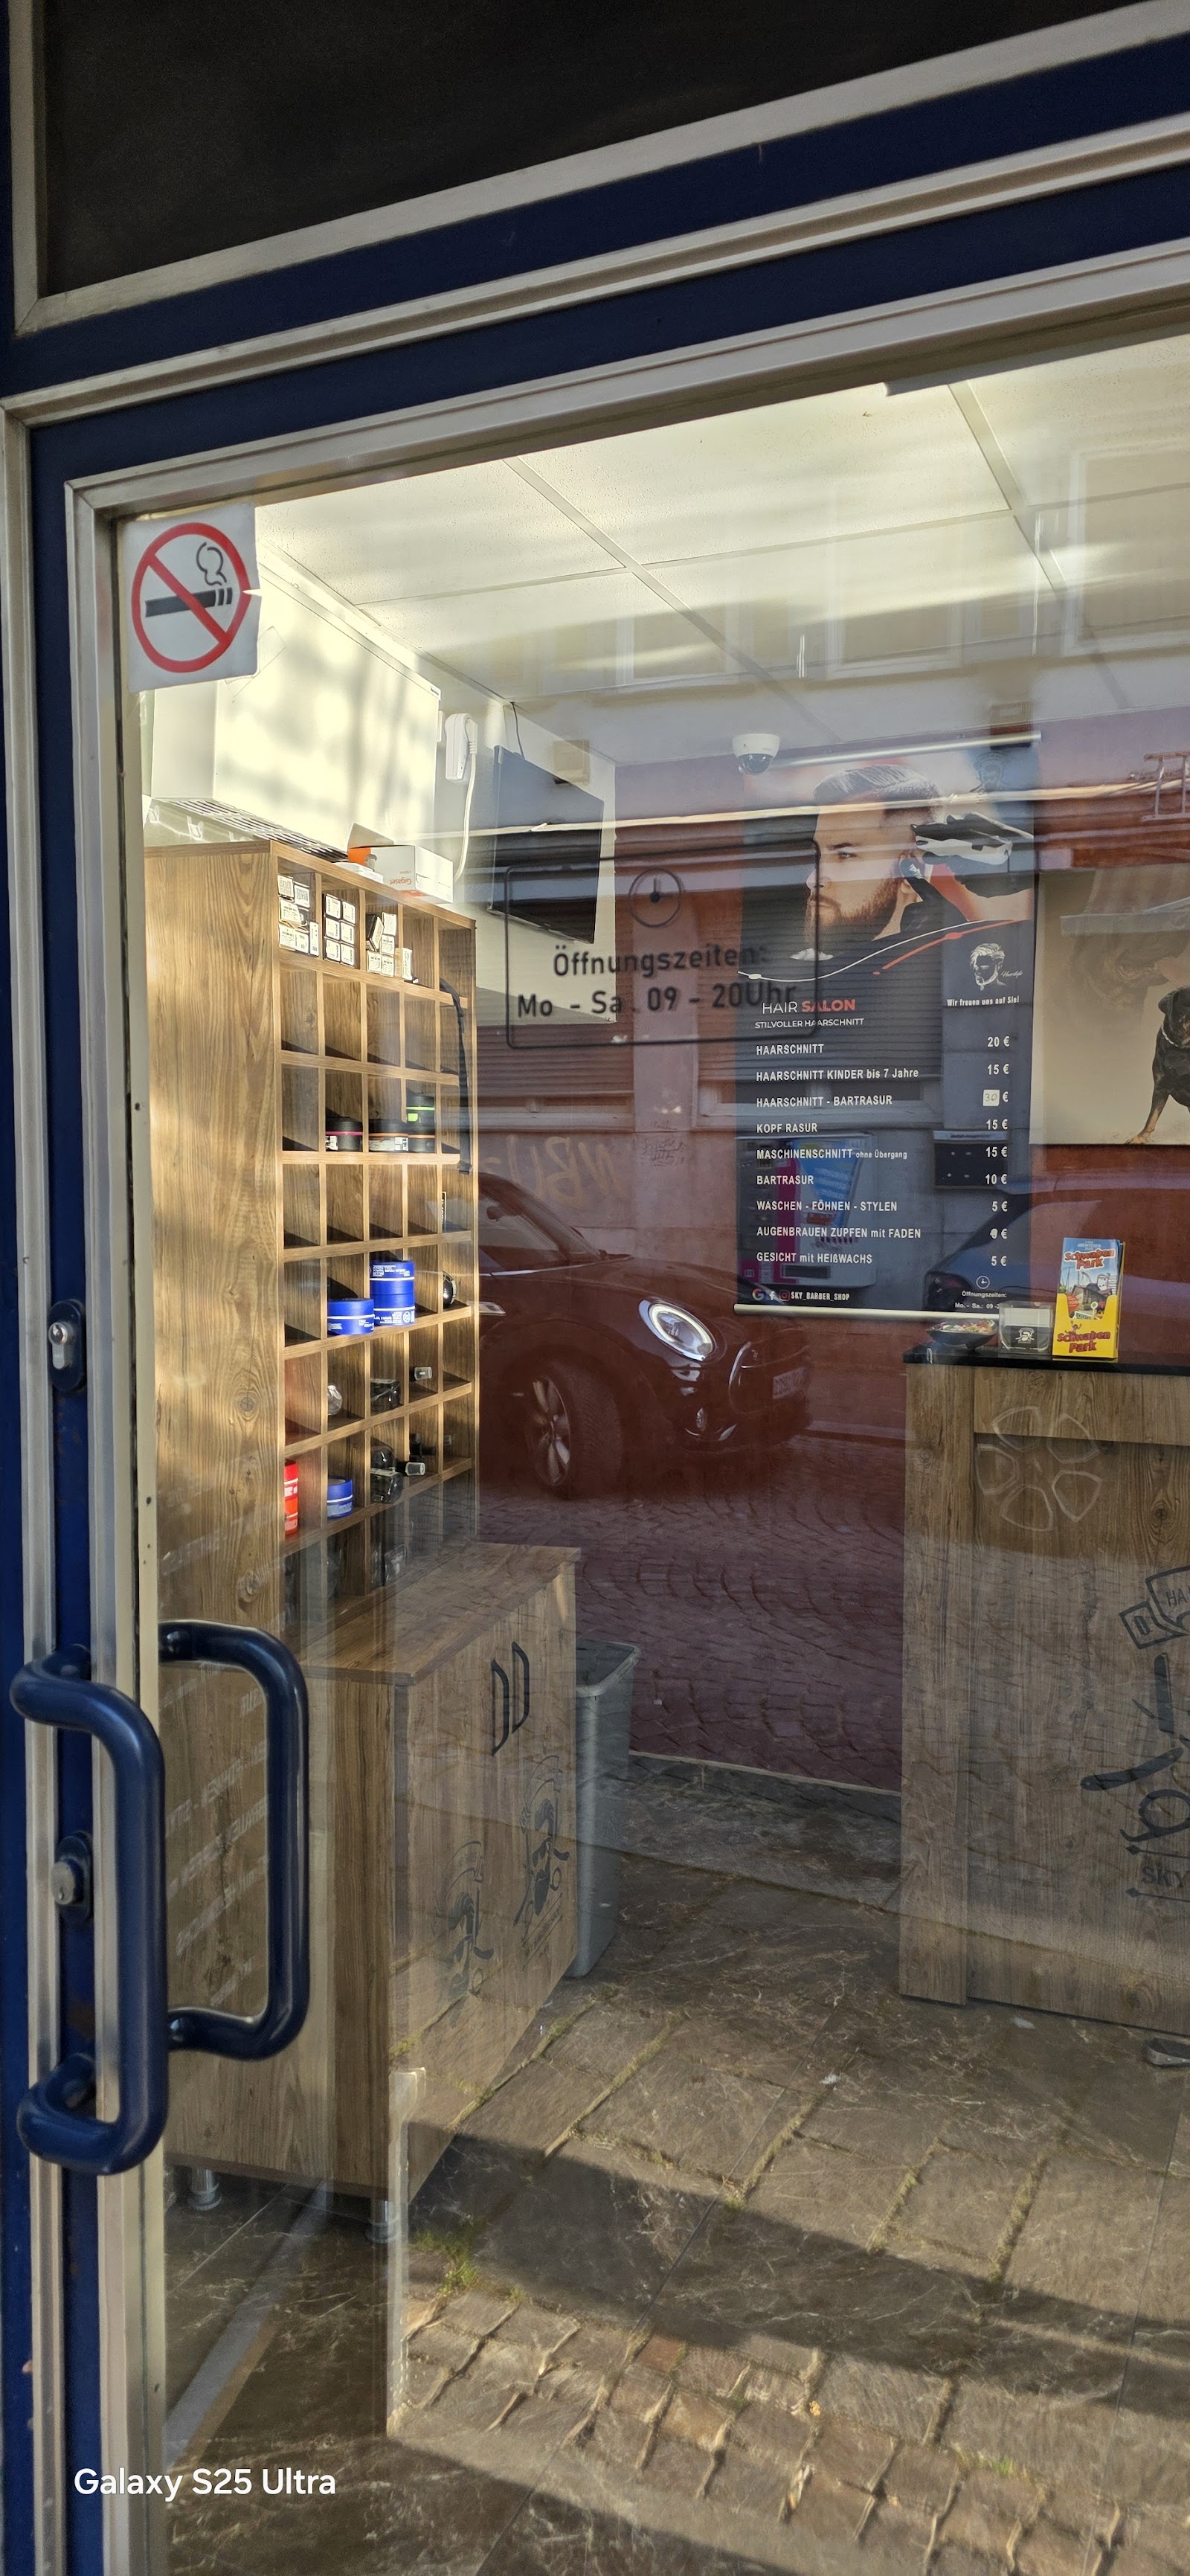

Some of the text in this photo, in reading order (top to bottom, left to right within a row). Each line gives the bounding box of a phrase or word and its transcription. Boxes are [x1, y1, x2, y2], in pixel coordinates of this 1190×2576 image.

[389, 877, 412, 885] Gigaset
[648, 987, 678, 1012] 09
[959, 998, 980, 1006] freuen
[995, 997, 1006, 1005] auf
[1007, 995, 1020, 1003] Sie!
[762, 999, 856, 1014] HAIR SALON
[755, 1018, 864, 1029] STILVOLLER HAARSCHNITT
[987, 1035, 1010, 1047] 20 €
[756, 1044, 824, 1055] HAARSCHNITT
[987, 1063, 1009, 1075] 15 €
[756, 1068, 919, 1082] HAARSCHNITT KINDER bis 7 Jahre
[756, 1096, 823, 1107] HAARSCHNITT
[833, 1095, 892, 1106] BARTRASUR
[985, 1091, 1009, 1102] 30 €
[756, 1122, 818, 1134] KOPF RASUR
[985, 1119, 1008, 1130] 15 €
[757, 1149, 853, 1159] MASCHINENSCHNITT
[875, 1149, 907, 1160] Übergang
[985, 1146, 1008, 1157] 15 €
[757, 1175, 814, 1185] BARTRASUR
[985, 1173, 1007, 1184] 10 €
[756, 1201, 802, 1211] WASCHEN
[812, 1199, 850, 1211] FÖHNEN
[860, 1201, 897, 1212] STYLEN
[991, 1201, 1008, 1212] 5 €
[756, 1227, 921, 1239] AUGENBRAUEN ZUPFEN mit FADEN
[1000, 1228, 1007, 1239] €
[756, 1252, 872, 1264] GESICHT mit HEIßWACHS
[1064, 1250, 1115, 1260] Schwaben
[991, 1256, 1007, 1266] 5 €
[1076, 1258, 1103, 1269] Park
[791, 1291, 850, 1301] SKY_BARBER_SHOP
[962, 1291, 1007, 1299] Öffnungszeiten:
[1057, 1331, 1111, 1342] Schwaben
[1069, 1340, 1097, 1353] Park
[1166, 1586, 1190, 1607] HA
